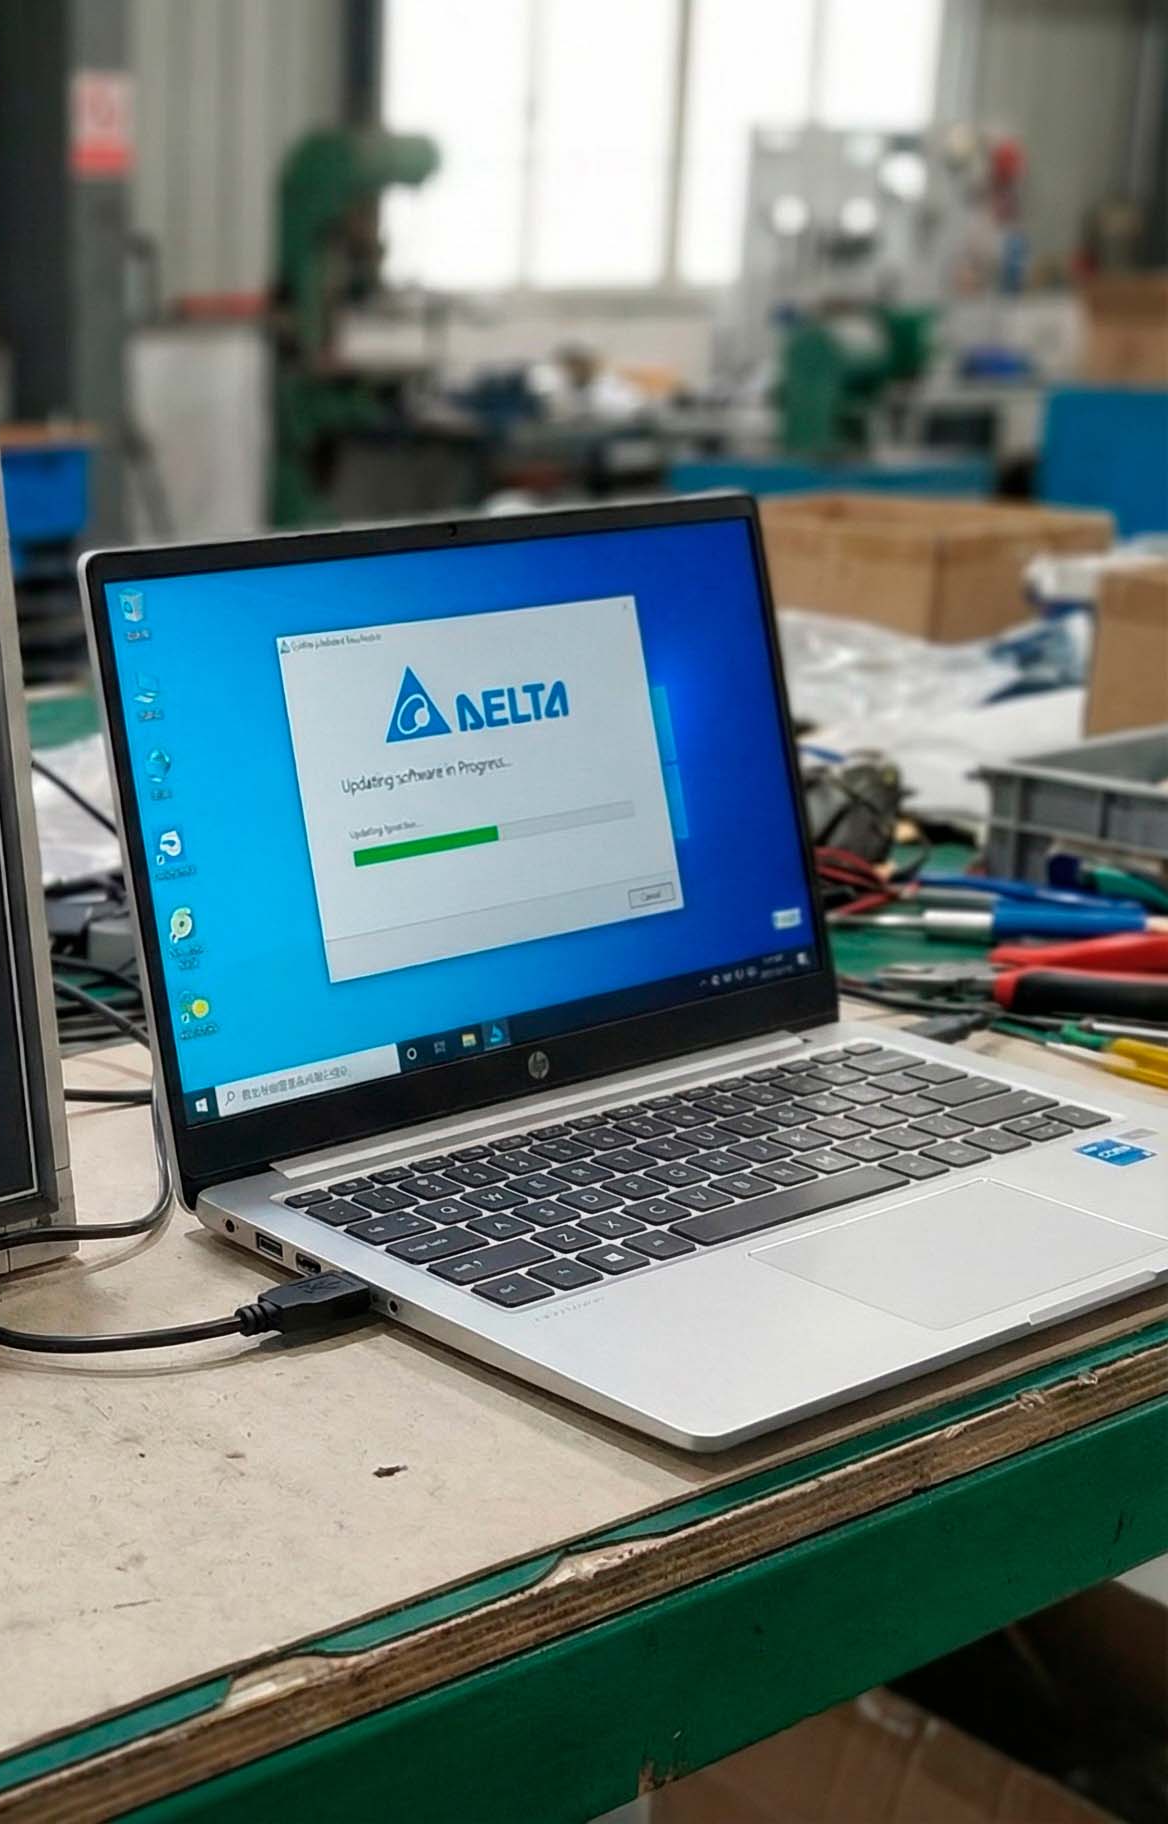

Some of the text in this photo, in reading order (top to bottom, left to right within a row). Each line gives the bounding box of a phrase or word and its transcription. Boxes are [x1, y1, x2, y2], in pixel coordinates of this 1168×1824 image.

[456, 680, 569, 732] DELTA
[341, 776, 394, 796] Updating
[446, 763, 456, 777] in
